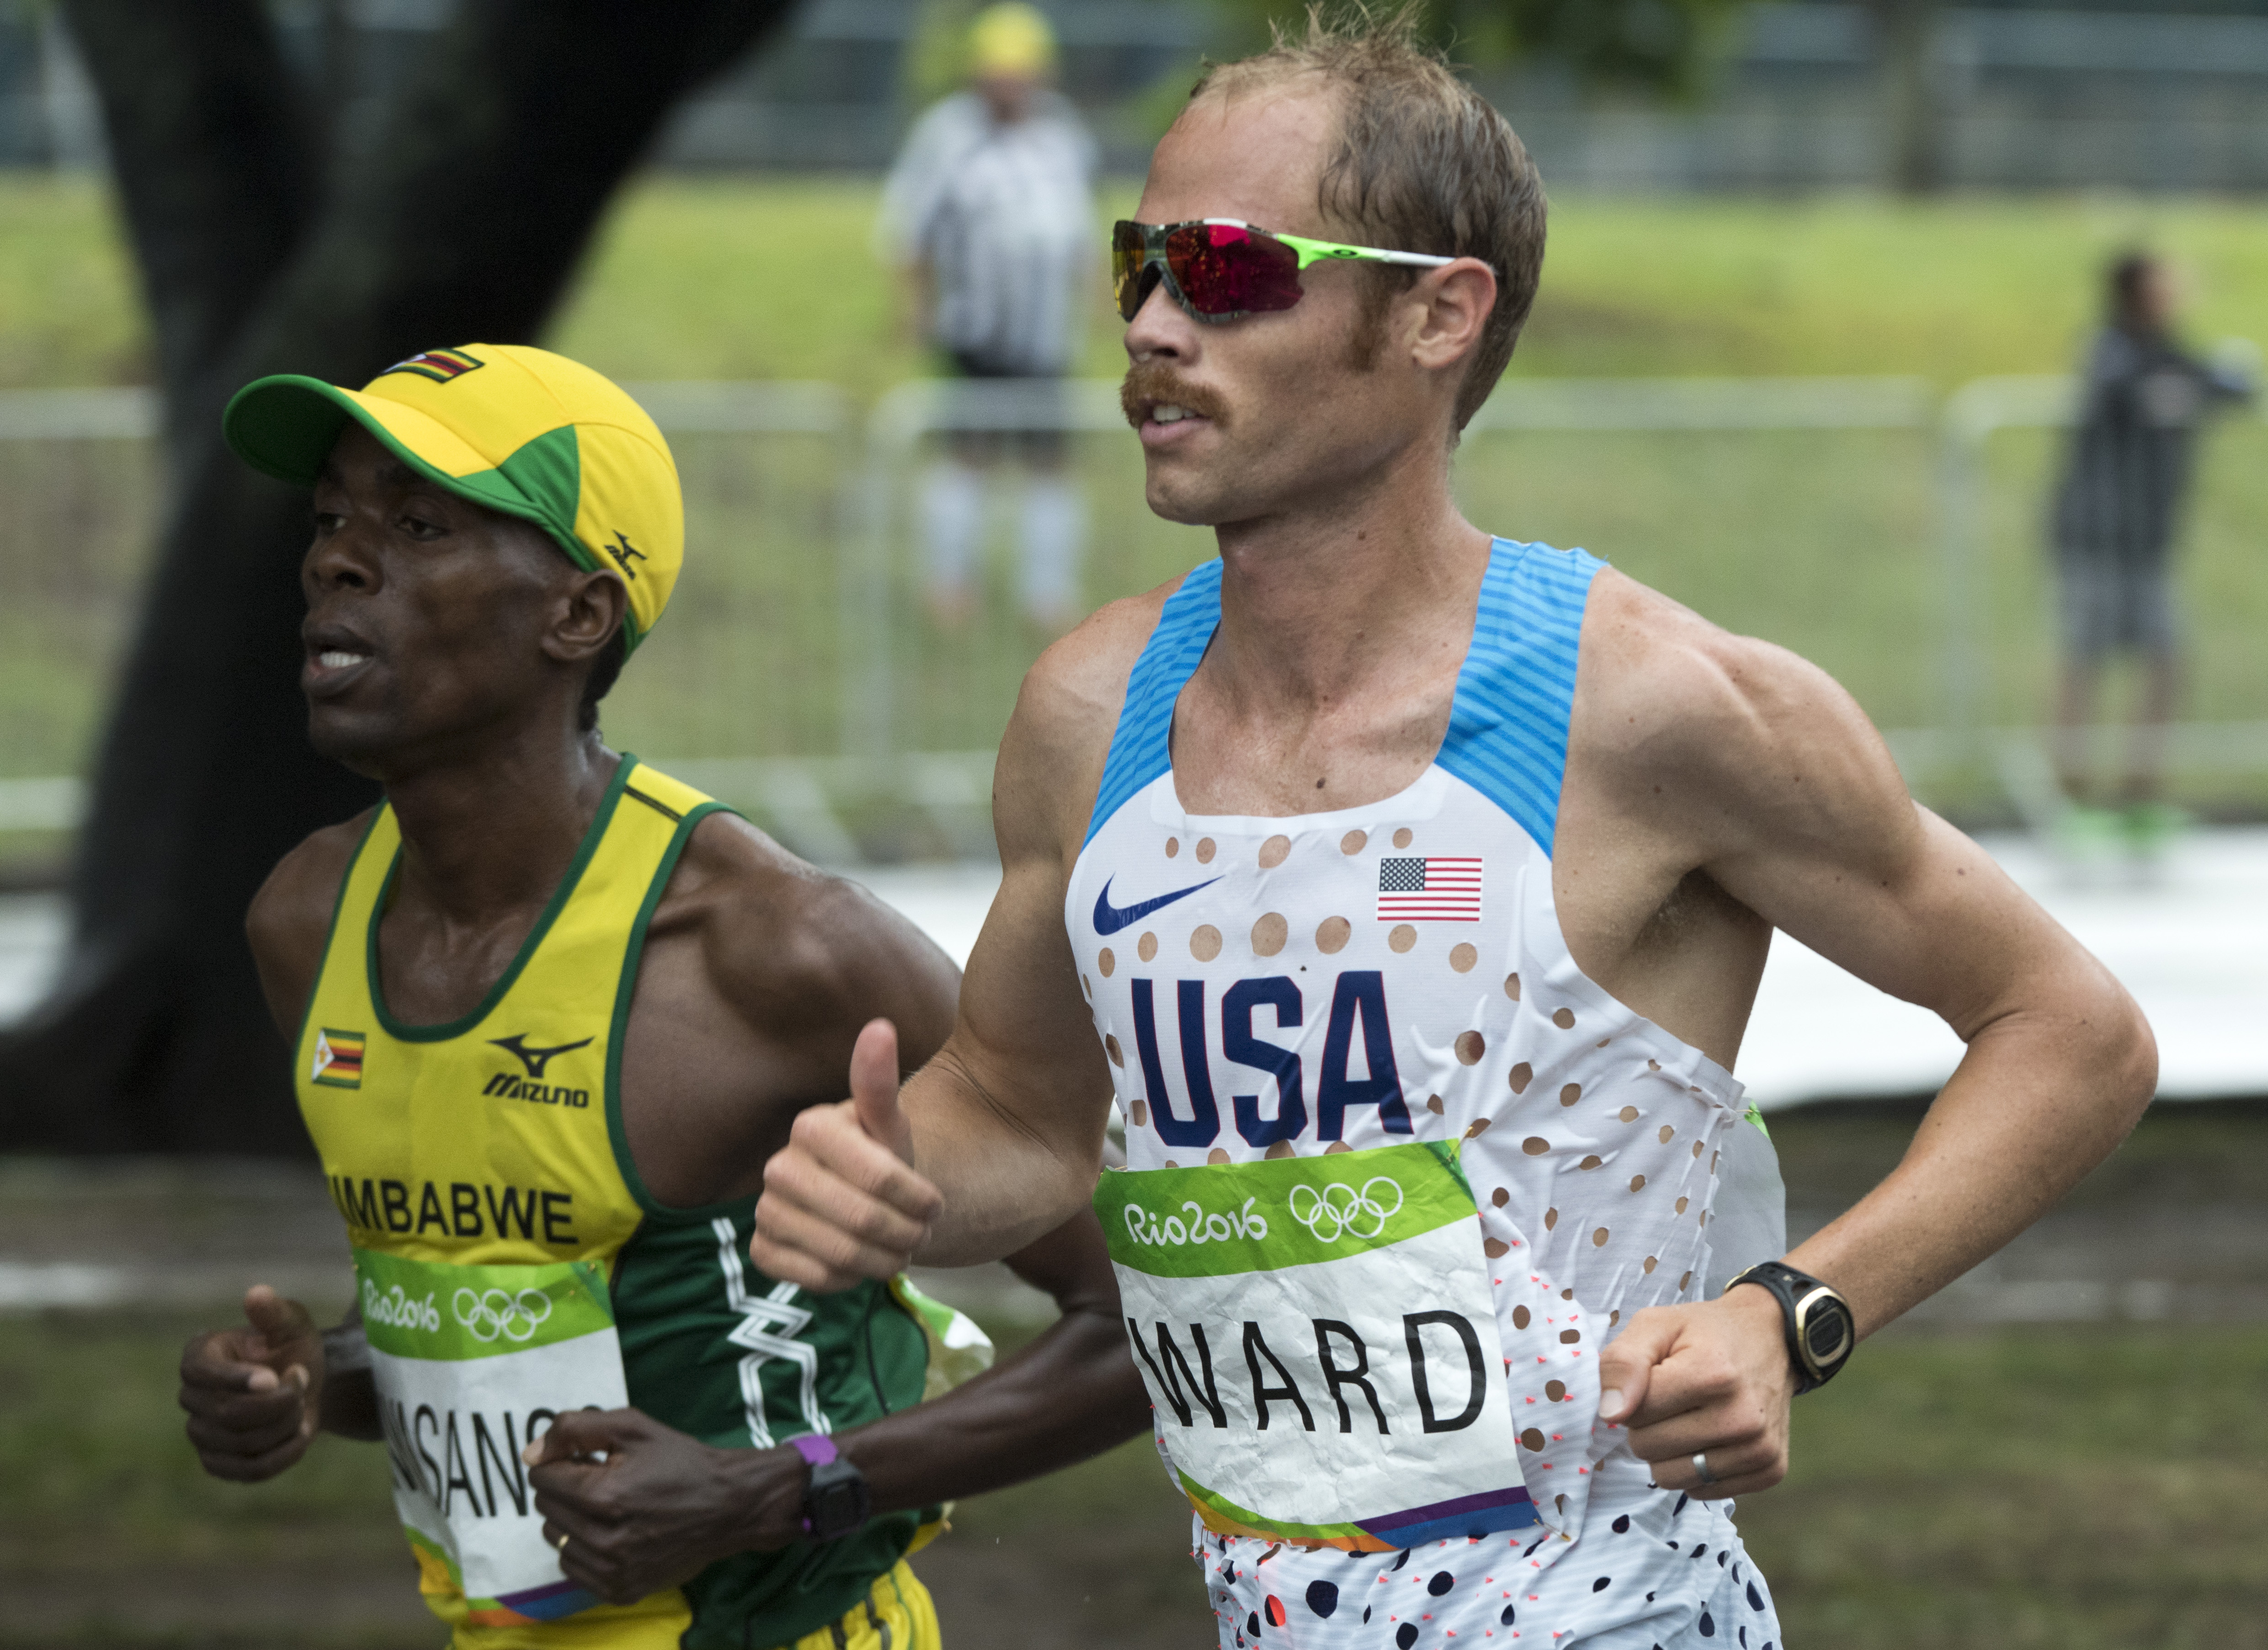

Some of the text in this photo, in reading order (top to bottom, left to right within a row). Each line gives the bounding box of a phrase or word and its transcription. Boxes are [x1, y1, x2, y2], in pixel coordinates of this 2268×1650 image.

[482, 1072, 589, 1109] MIZUNO
[1130, 970, 1415, 1148] USA
[332, 1175, 579, 1245] IMBABWE
[1124, 1197, 1268, 1246] Rio2016
[1127, 1310, 1487, 1435] WARD
